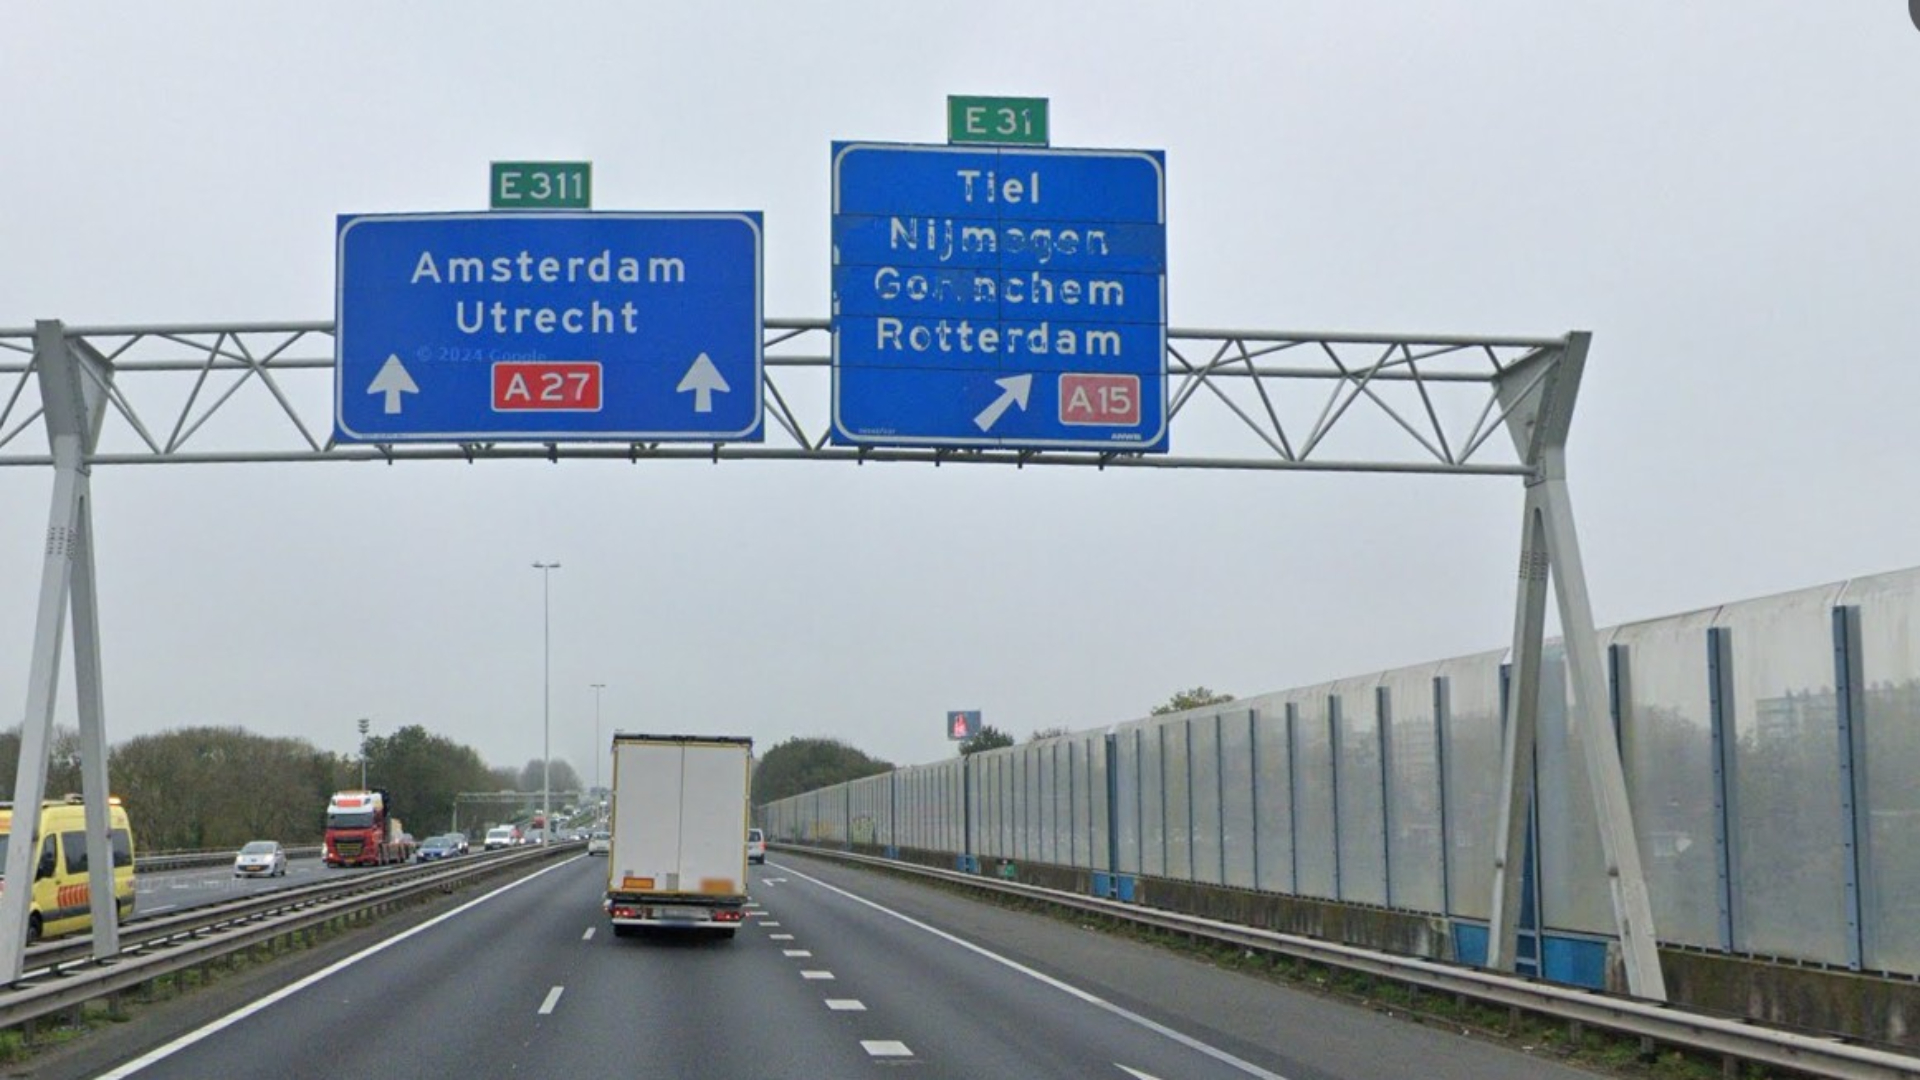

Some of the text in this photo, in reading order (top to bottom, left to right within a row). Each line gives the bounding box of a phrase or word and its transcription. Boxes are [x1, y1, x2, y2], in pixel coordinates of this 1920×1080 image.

[966, 106, 1031, 135] E 31
[501, 172, 582, 199] E 311
[957, 170, 1039, 203] Tiel
[411, 249, 686, 284] Amsterdam
[874, 266, 1124, 306] Gonchem
[456, 300, 638, 334] Utrecht
[877, 317, 1121, 356] Rotterdam
[504, 373, 590, 401] A 27
[1067, 386, 1131, 414] A 15
